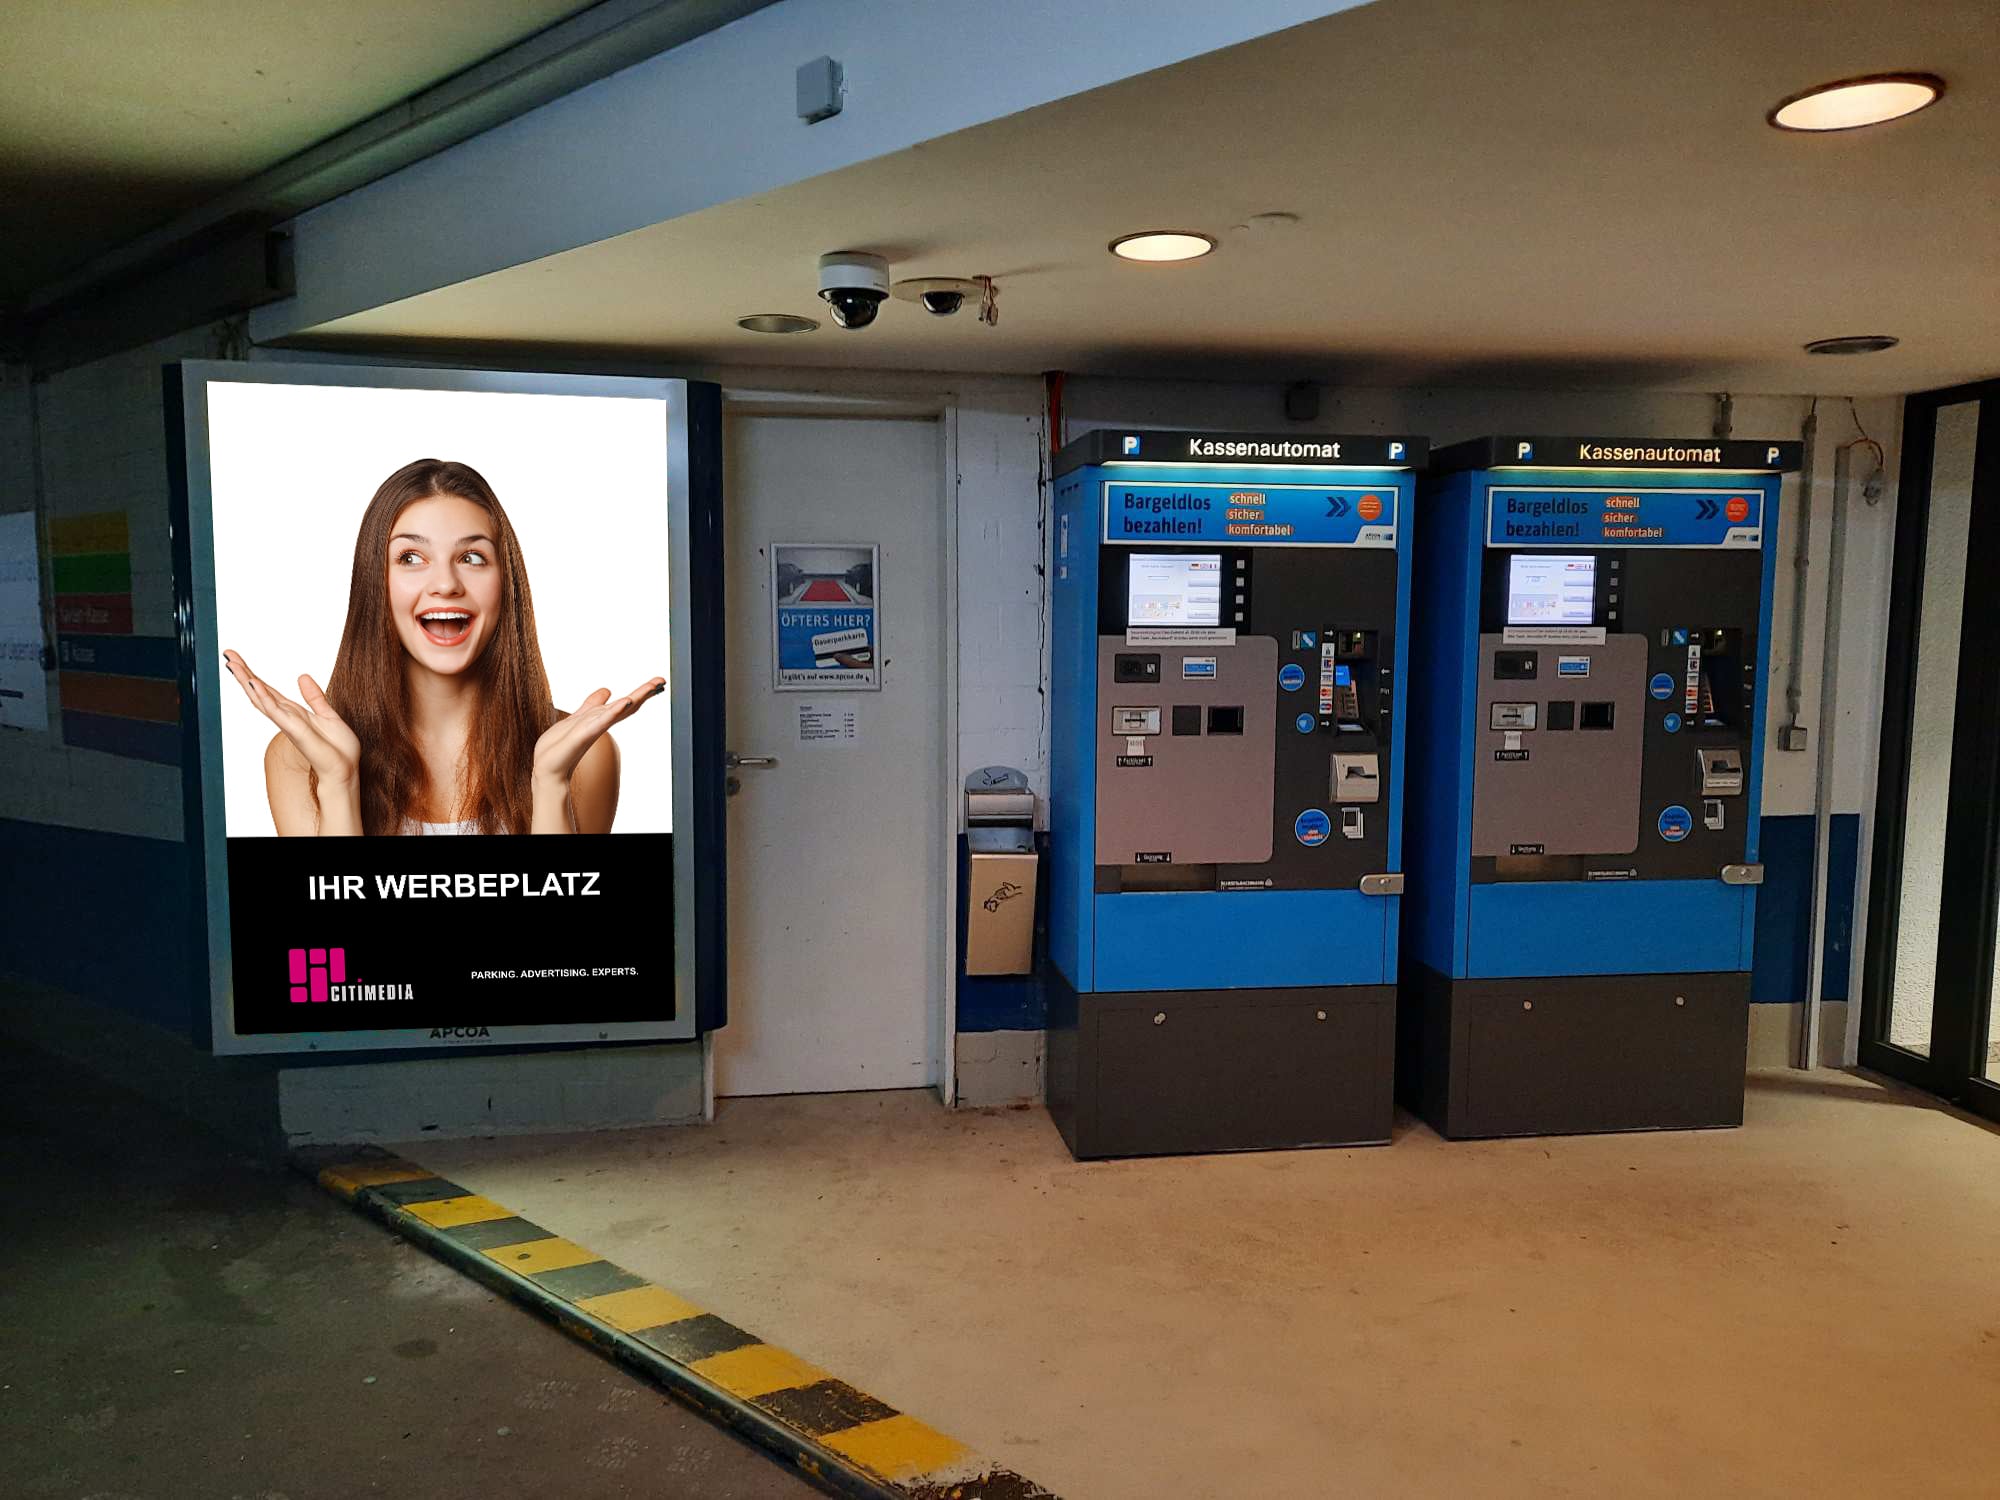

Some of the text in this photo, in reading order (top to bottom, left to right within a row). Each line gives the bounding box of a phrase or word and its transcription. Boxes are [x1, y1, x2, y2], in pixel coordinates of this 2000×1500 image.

[1190, 439, 1341, 458] Kassenautomat
[1580, 444, 1721, 463] Kassenautomat
[1124, 493, 1211, 511] Bargeldlos
[1229, 493, 1267, 505] schnell
[1605, 497, 1640, 509] schnell
[1228, 509, 1260, 520] sicher
[1507, 498, 1588, 517] Bargeldlos
[1604, 513, 1635, 523] sicher
[1124, 517, 1202, 534] bezahlen!
[1228, 524, 1292, 536] komfortabel
[1506, 521, 1580, 537] bezahlen!
[1604, 527, 1663, 539] komfortabel
[781, 612, 871, 627] ÖFTERS HIER?
[309, 871, 601, 900] IHR WERBEPLATZ
[471, 967, 639, 979] PARKING. ADVERTISING. EXPERTS.
[430, 1026, 490, 1039] APCOA
